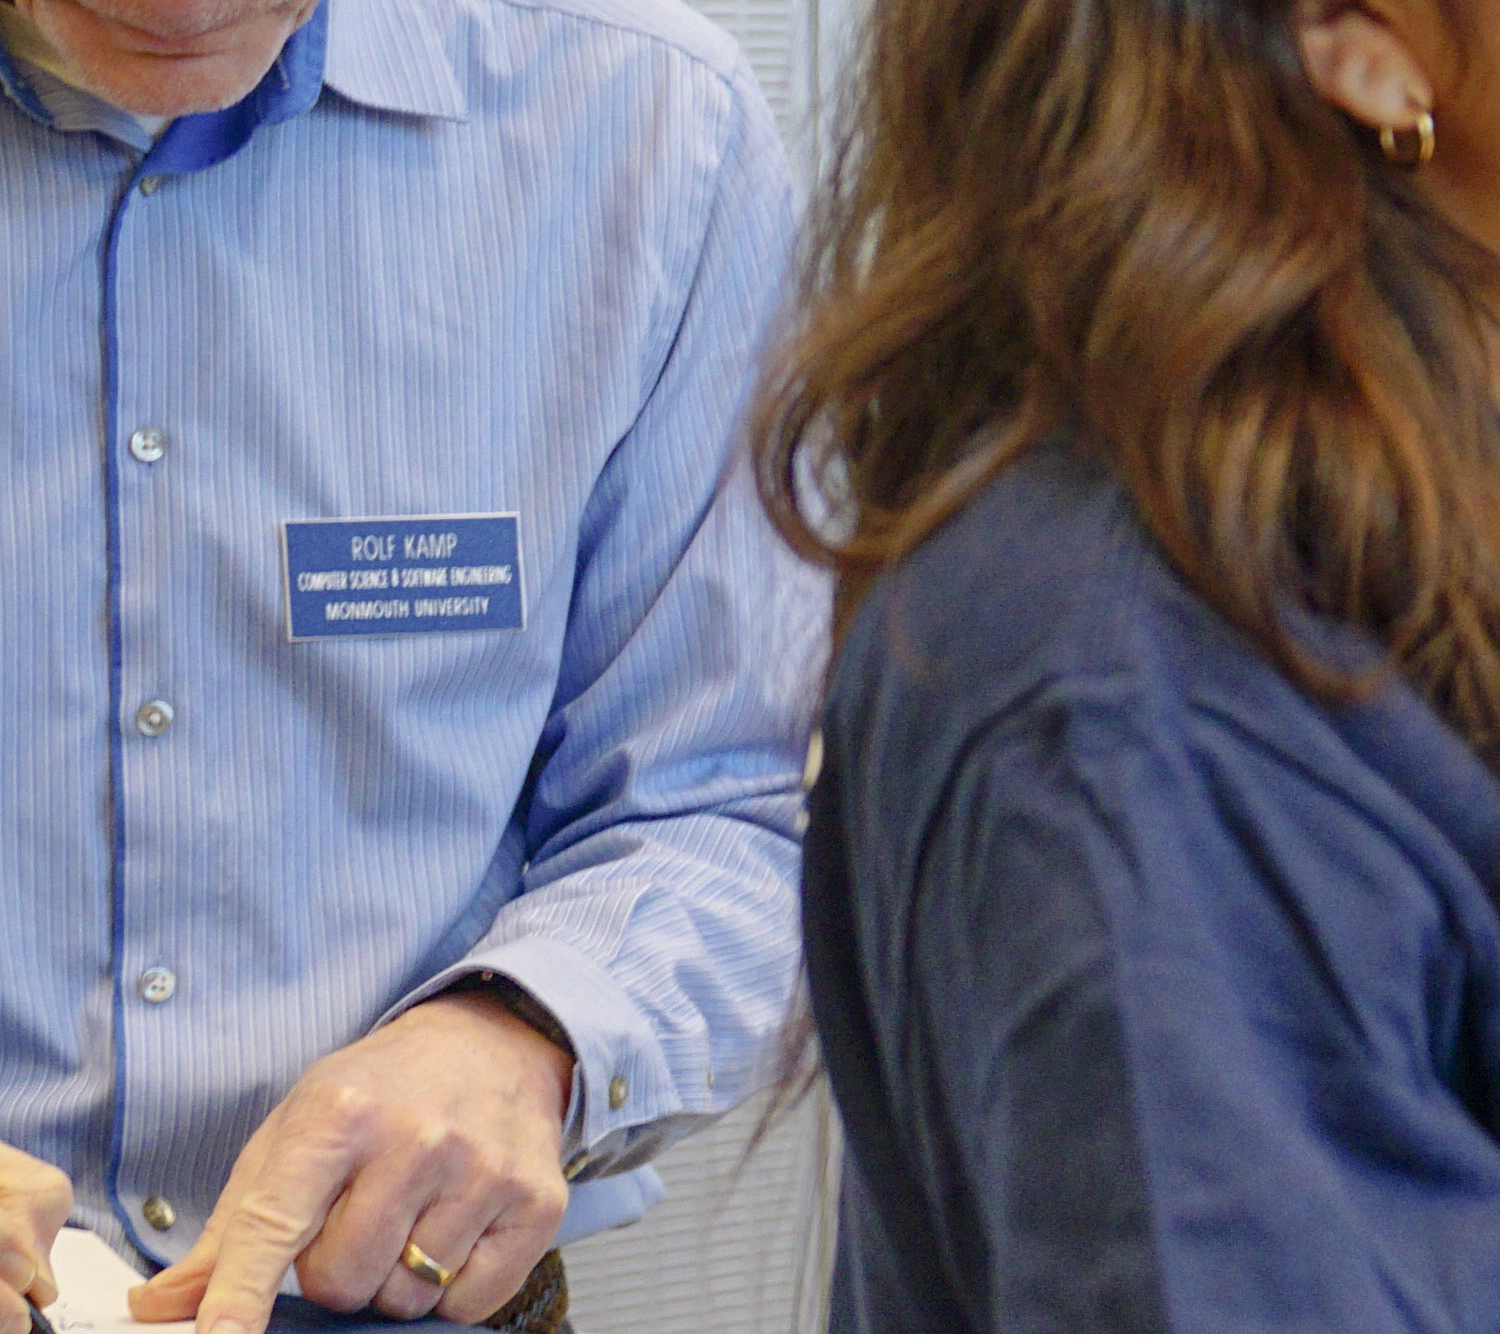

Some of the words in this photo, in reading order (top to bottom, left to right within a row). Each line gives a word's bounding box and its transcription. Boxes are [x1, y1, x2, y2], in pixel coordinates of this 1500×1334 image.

[351, 534, 396, 562] ROLF
[404, 532, 458, 560] KAMP
[297, 571, 348, 592] COMPUTER
[350, 569, 389, 590] SCIENCE
[402, 567, 448, 588] SOFTWARE
[450, 564, 513, 585] ENGINEERING
[325, 598, 410, 621] MONMOUTH
[414, 596, 490, 618] UNIVERSITY
